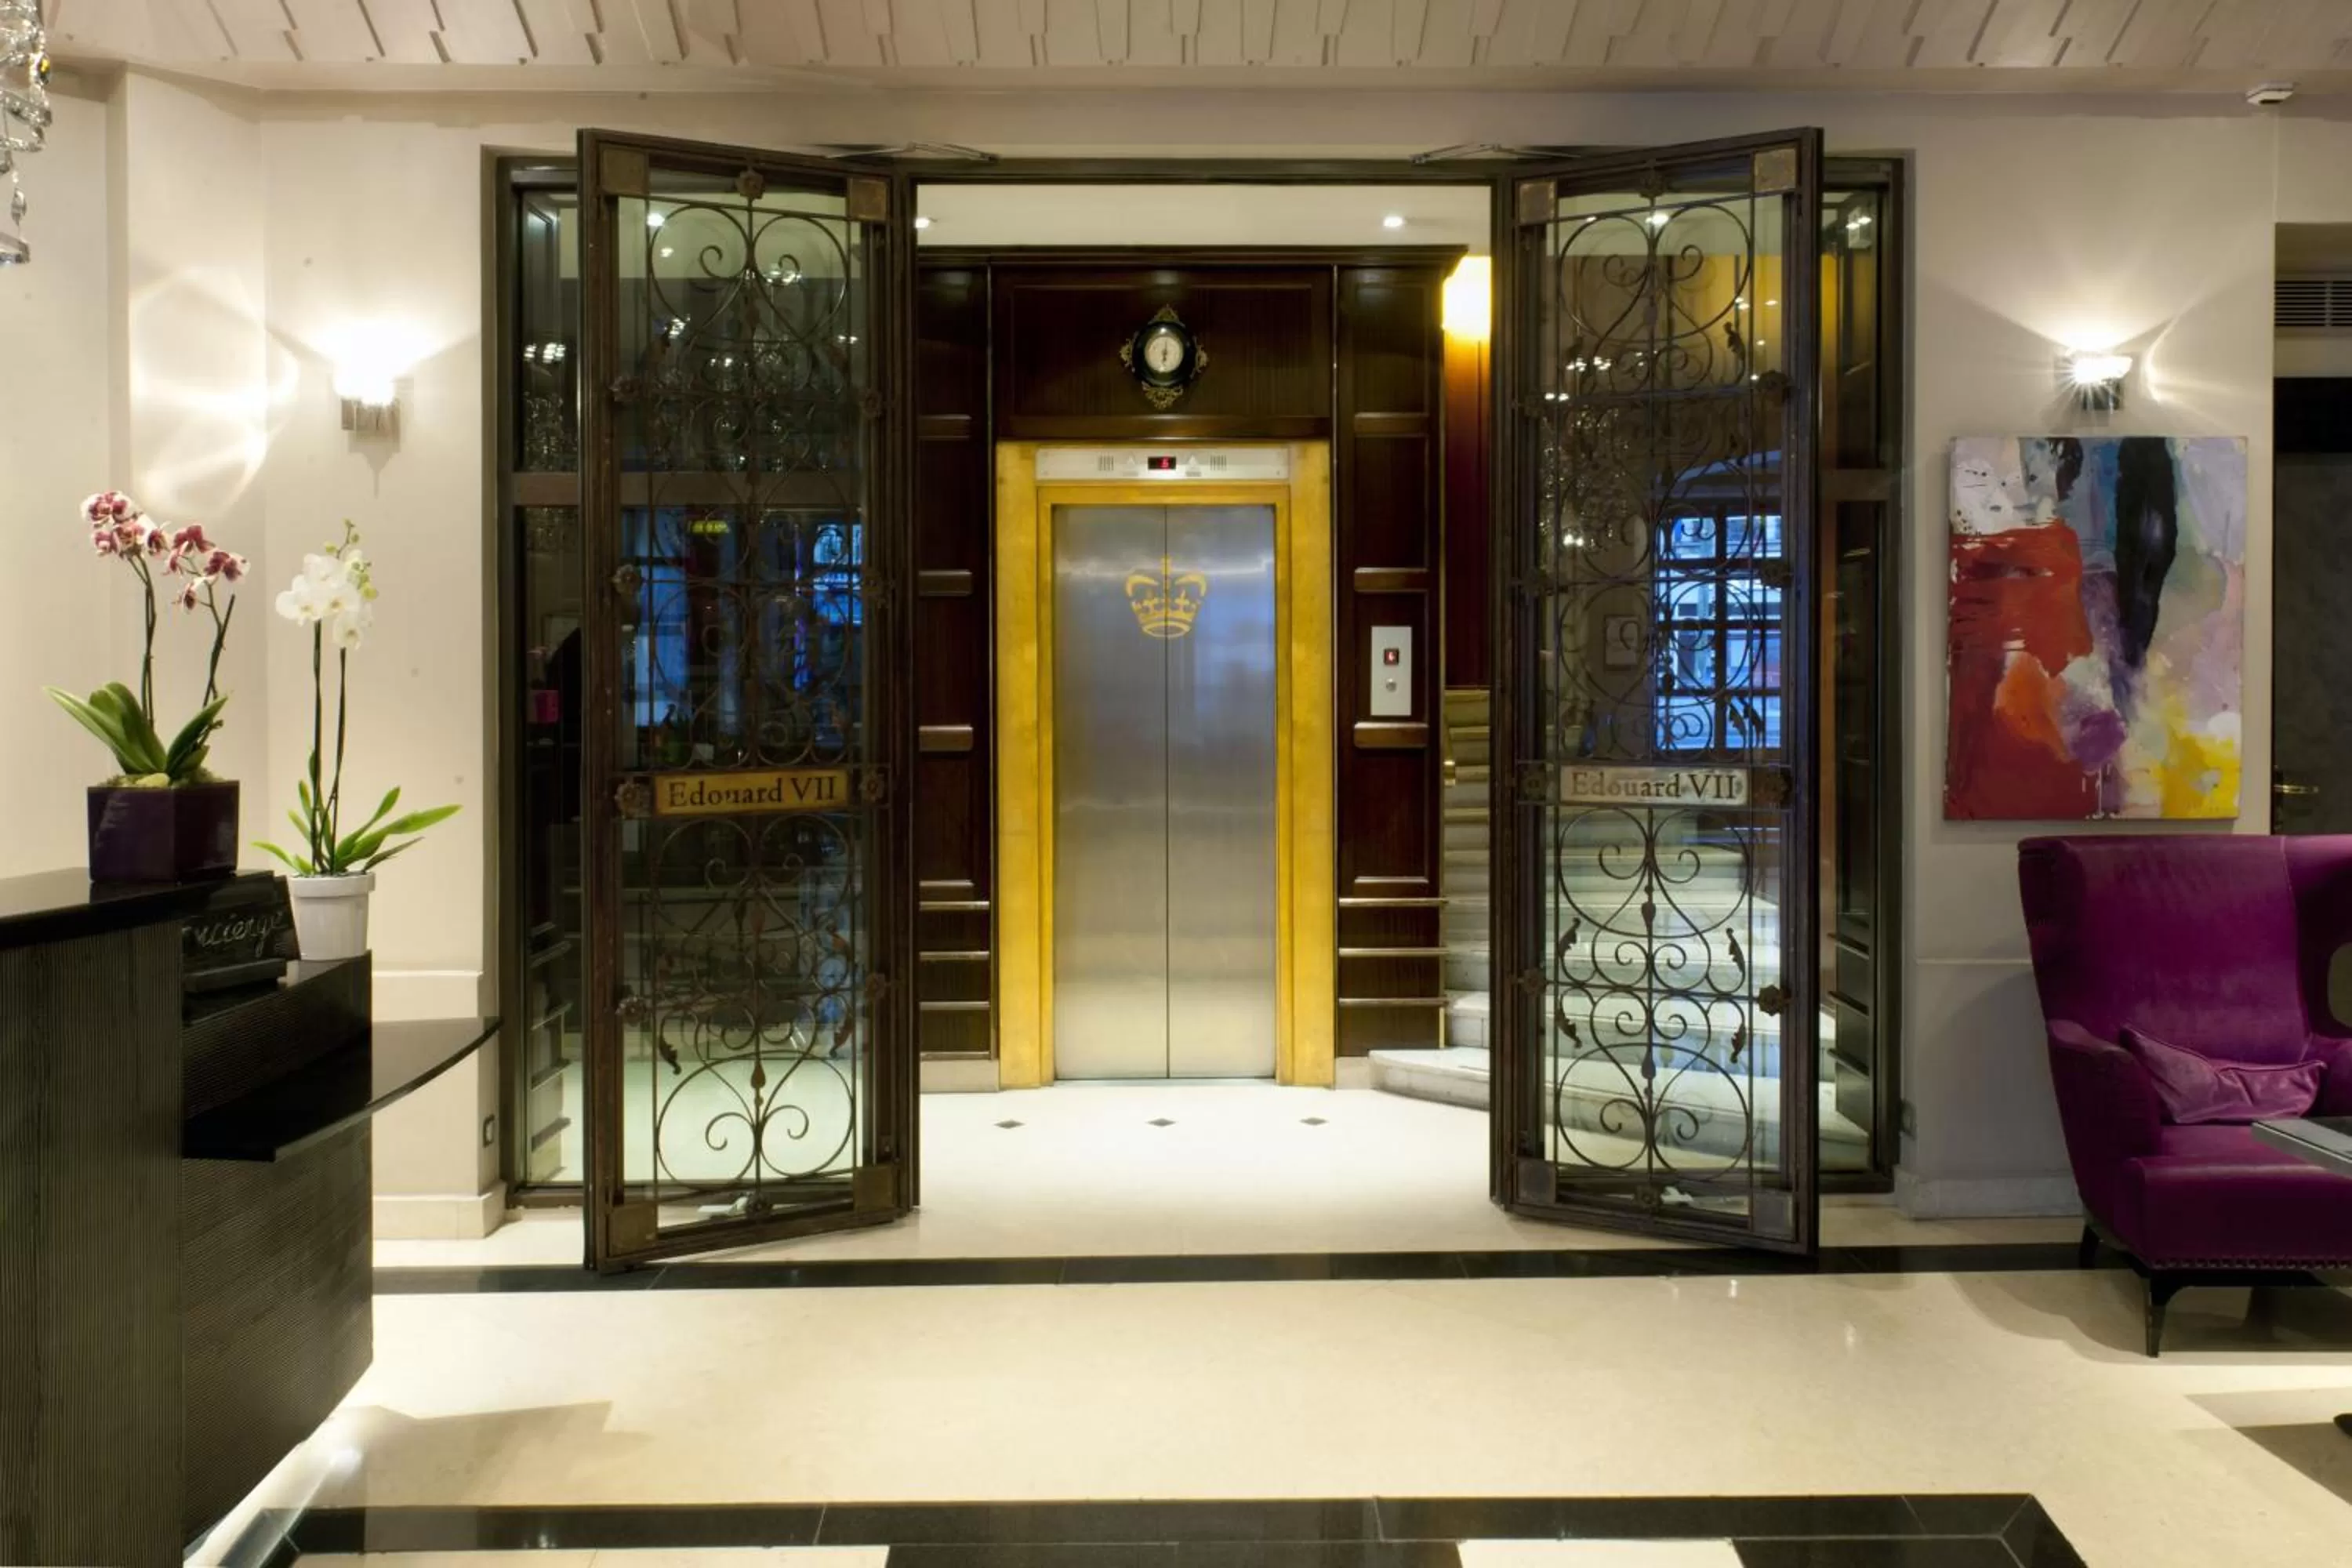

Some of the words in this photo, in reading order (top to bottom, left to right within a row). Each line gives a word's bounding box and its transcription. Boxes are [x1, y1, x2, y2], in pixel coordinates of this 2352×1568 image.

[669, 777, 783, 807] Edouard
[790, 776, 837, 801] VII
[1571, 771, 1681, 798] Edouard
[1689, 774, 1737, 800] VII
